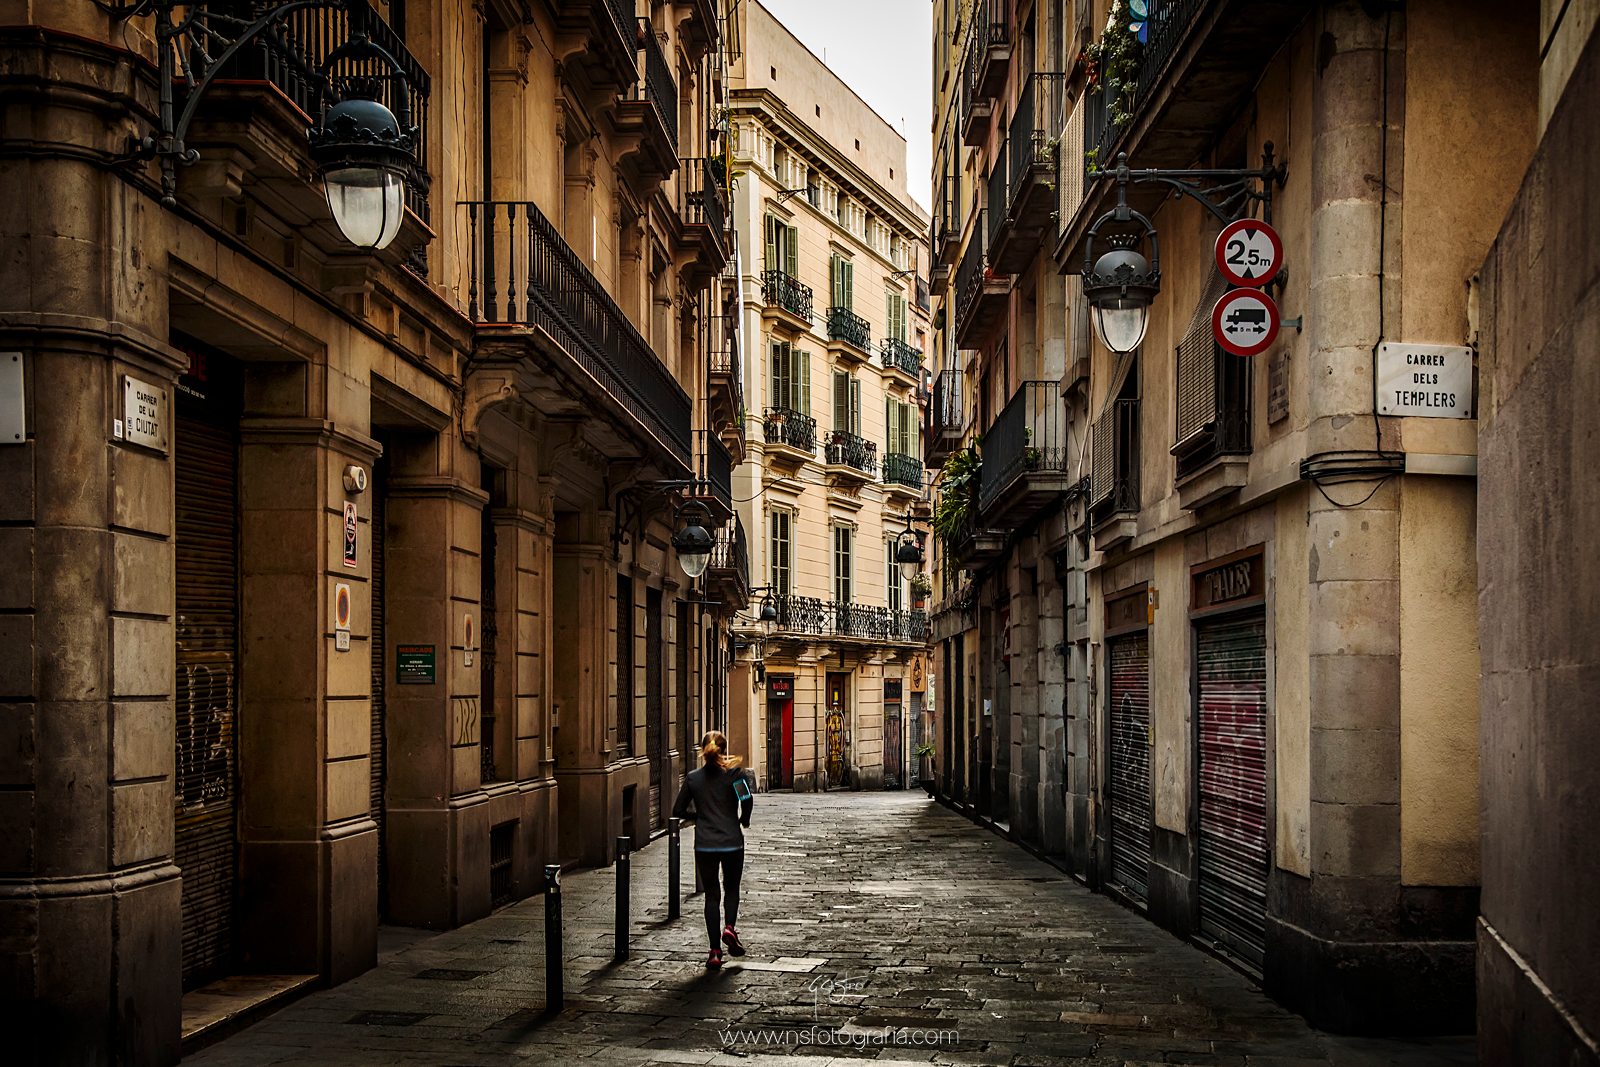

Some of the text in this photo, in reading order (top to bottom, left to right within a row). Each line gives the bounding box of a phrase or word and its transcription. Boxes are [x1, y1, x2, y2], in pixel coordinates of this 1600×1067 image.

[1407, 354, 1444, 366] CARRER
[1413, 373, 1438, 384] DELS
[136, 391, 158, 406] CARRER
[1395, 391, 1456, 408] TEMPLERS
[138, 405, 155, 418] DE LA
[136, 418, 158, 437] CIUTAT
[1206, 561, 1251, 603] THALES
